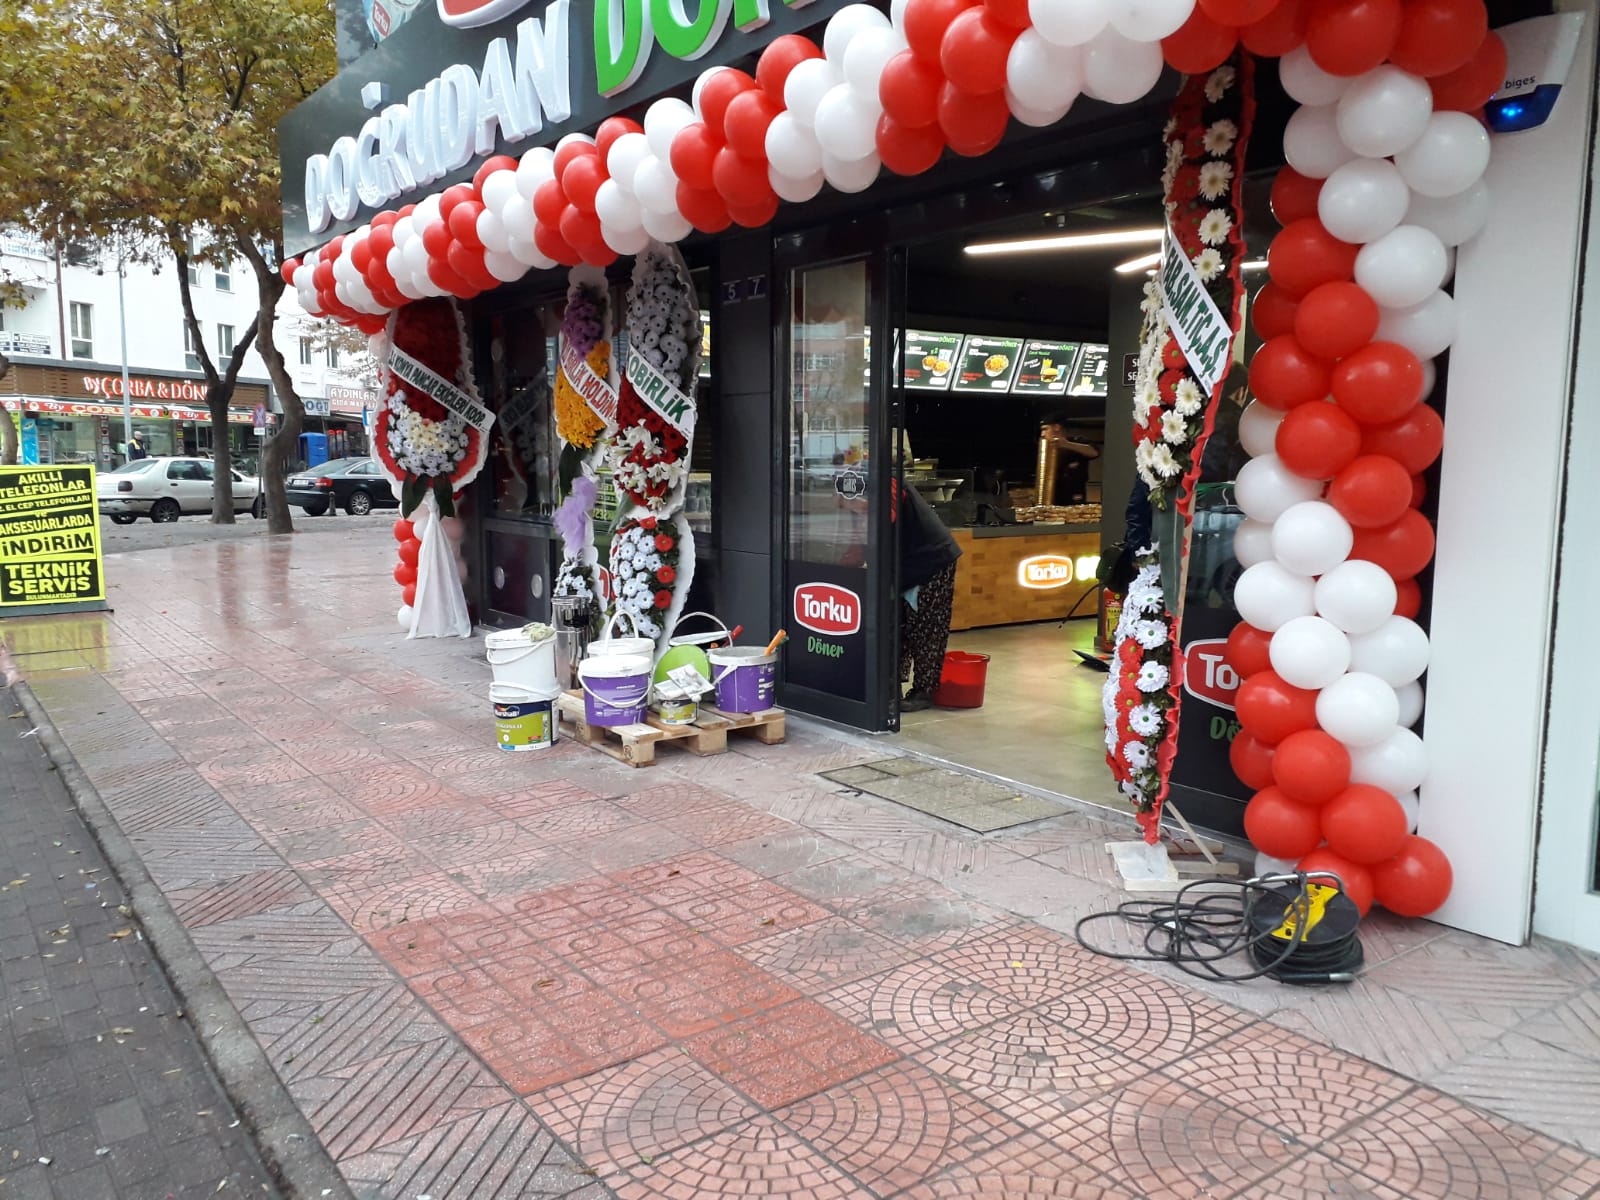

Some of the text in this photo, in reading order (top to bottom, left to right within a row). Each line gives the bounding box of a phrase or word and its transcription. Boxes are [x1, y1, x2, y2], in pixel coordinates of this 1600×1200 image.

[1505, 76, 1536, 89] biges
[18, 471, 63, 485] AKILLI
[0, 480, 86, 498] TELEFONLAR
[0, 514, 93, 536] AKSESUARLARDA
[801, 593, 852, 624] Torku
[807, 636, 844, 658] Döner
